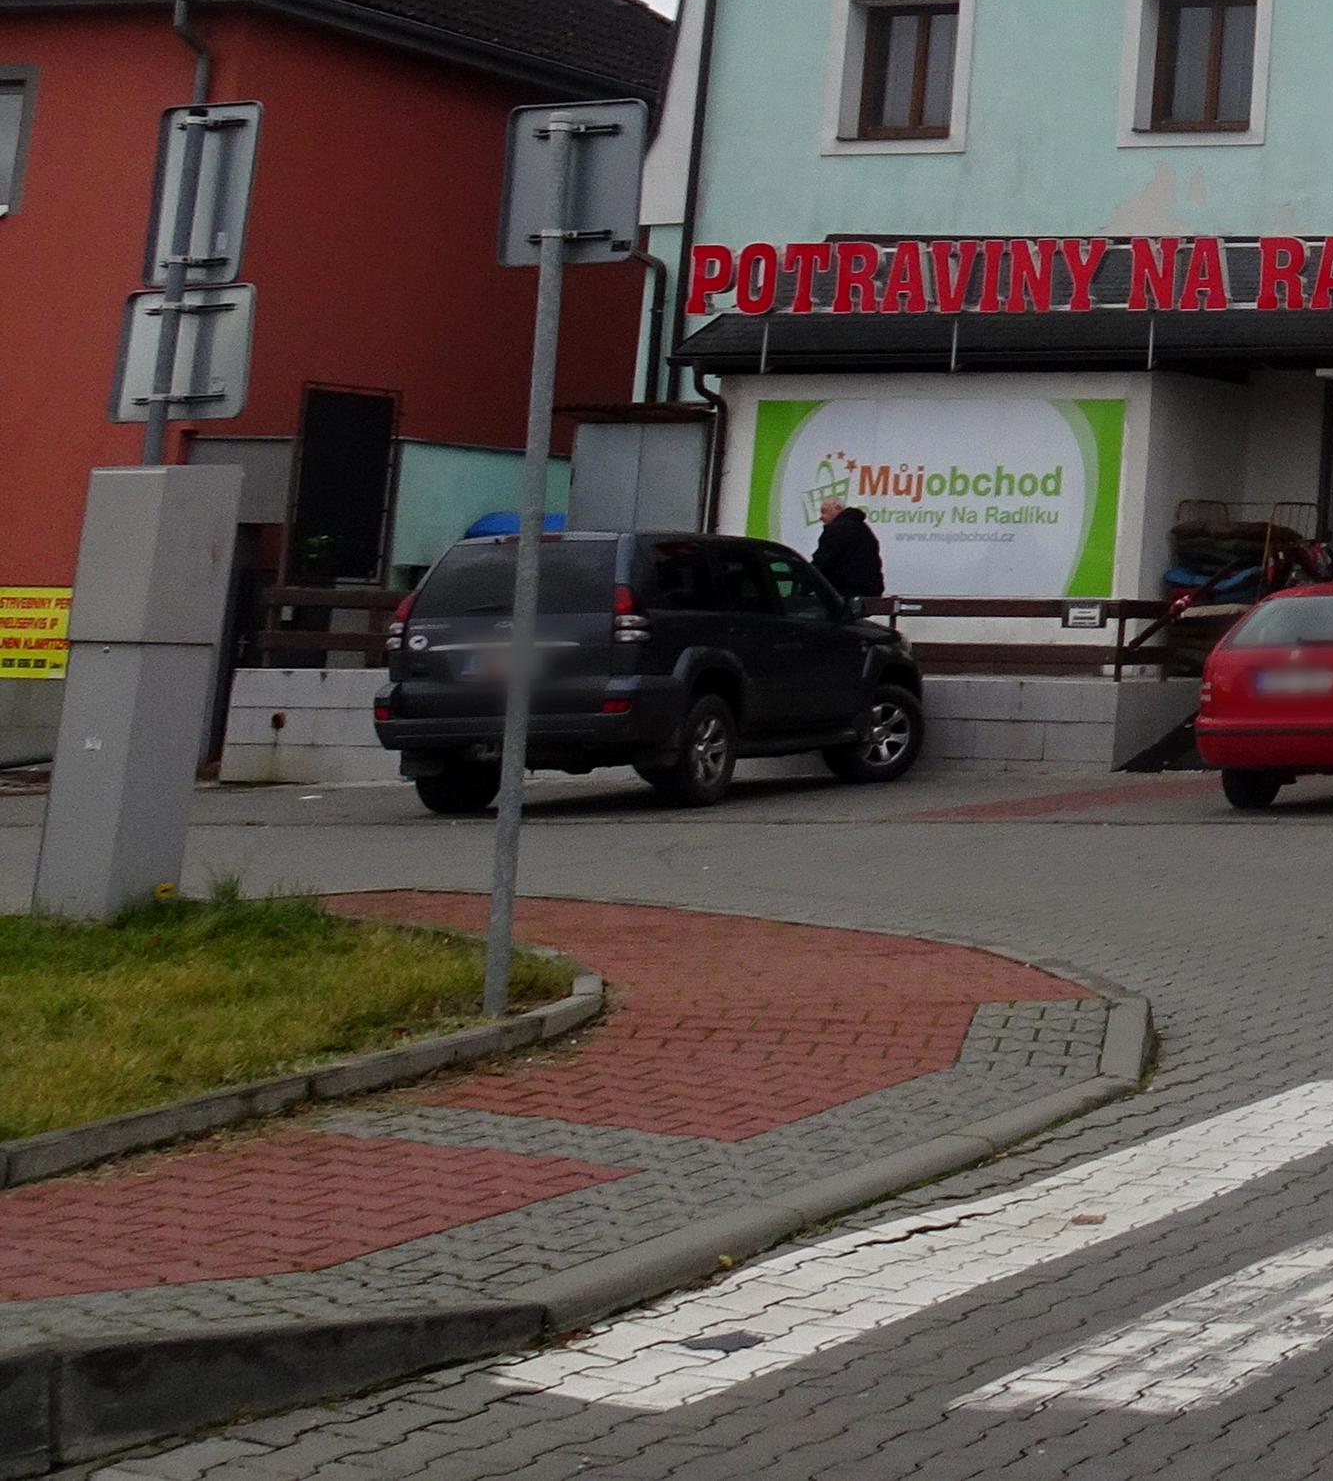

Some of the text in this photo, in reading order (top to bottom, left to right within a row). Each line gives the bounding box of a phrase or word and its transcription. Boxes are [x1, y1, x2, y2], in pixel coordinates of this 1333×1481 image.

[686, 239, 1107, 316] POTRAVINY
[1127, 236, 1229, 311] NA
[952, 506, 978, 524] Na
[985, 505, 1059, 525] Radlíku
